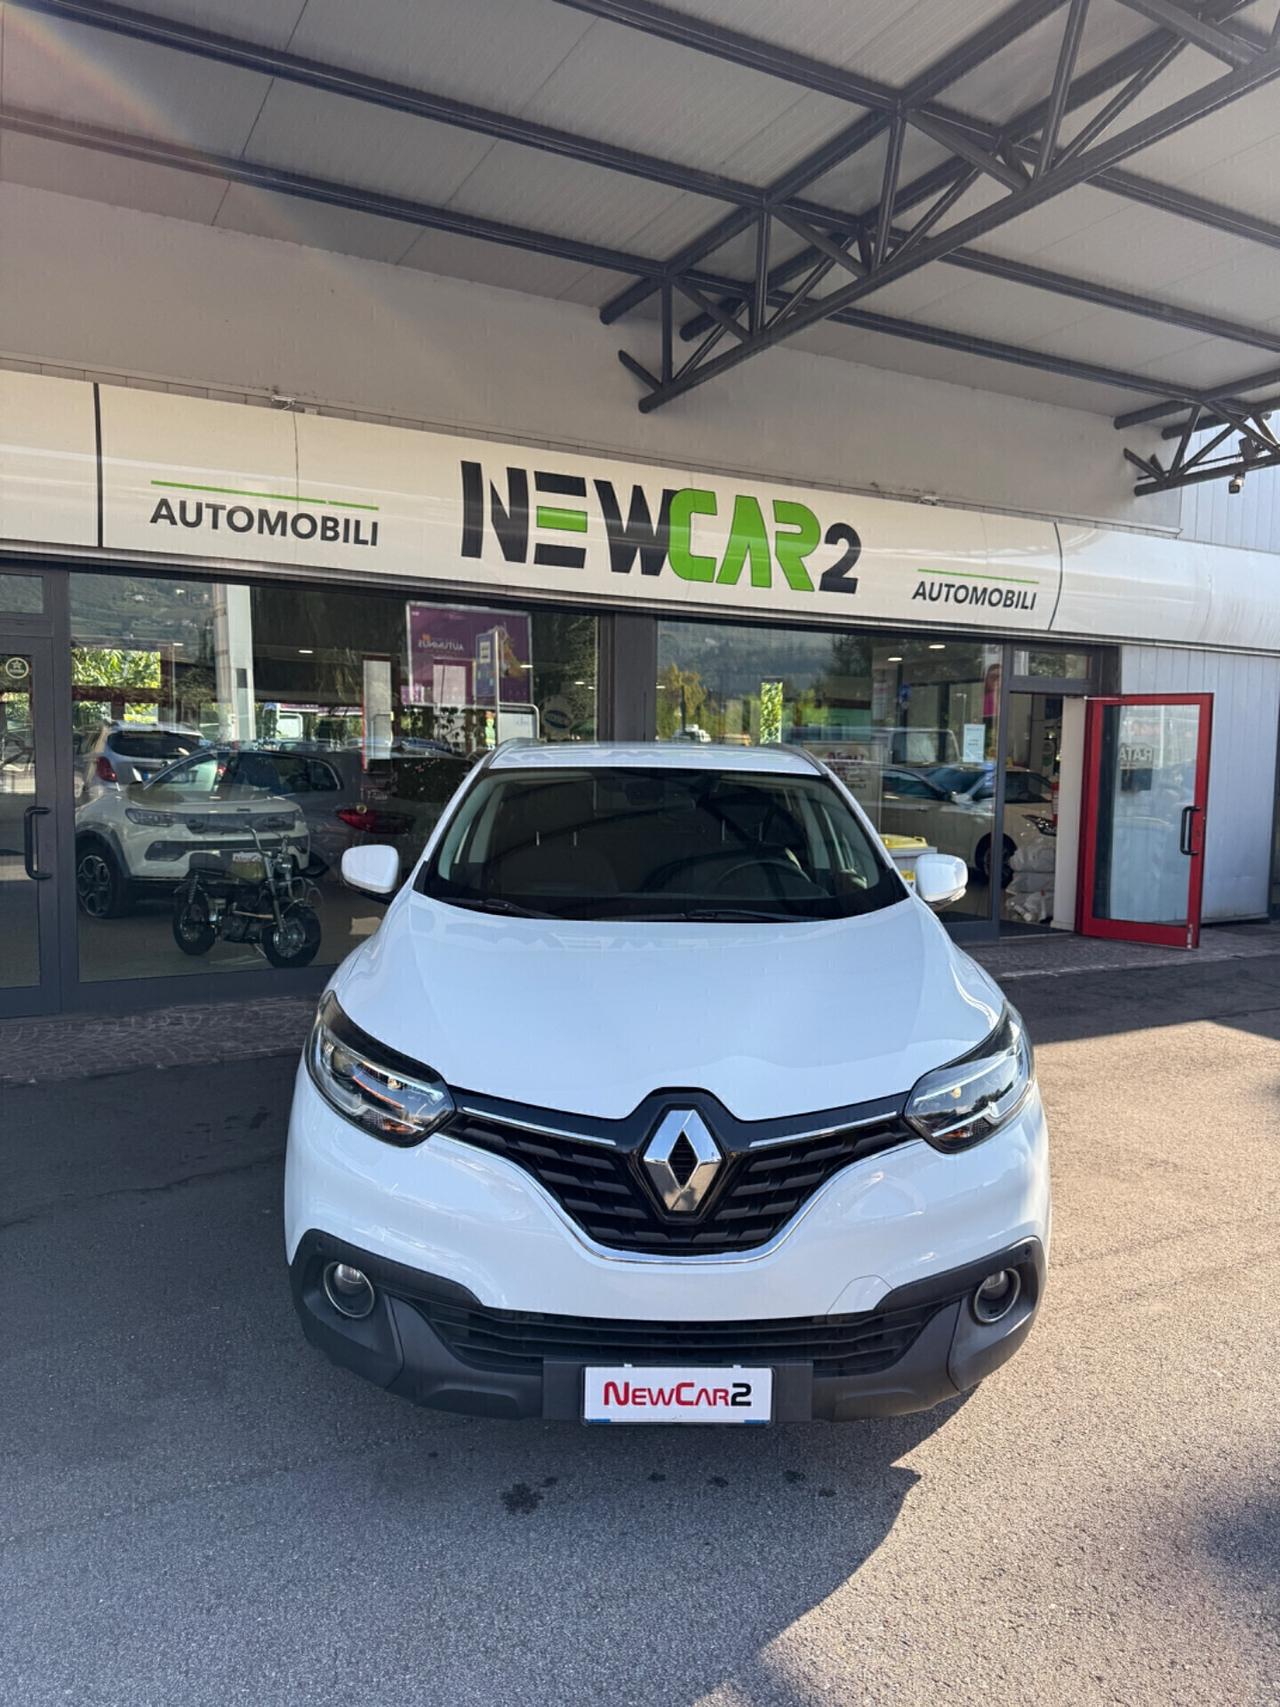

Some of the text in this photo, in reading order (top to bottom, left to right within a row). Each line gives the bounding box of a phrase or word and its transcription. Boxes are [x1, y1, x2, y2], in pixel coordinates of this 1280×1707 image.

[150, 498, 379, 546] AUTOMOBILI
[461, 460, 862, 594] NEWCAR2
[912, 581, 1037, 610] AUTOMOBILI
